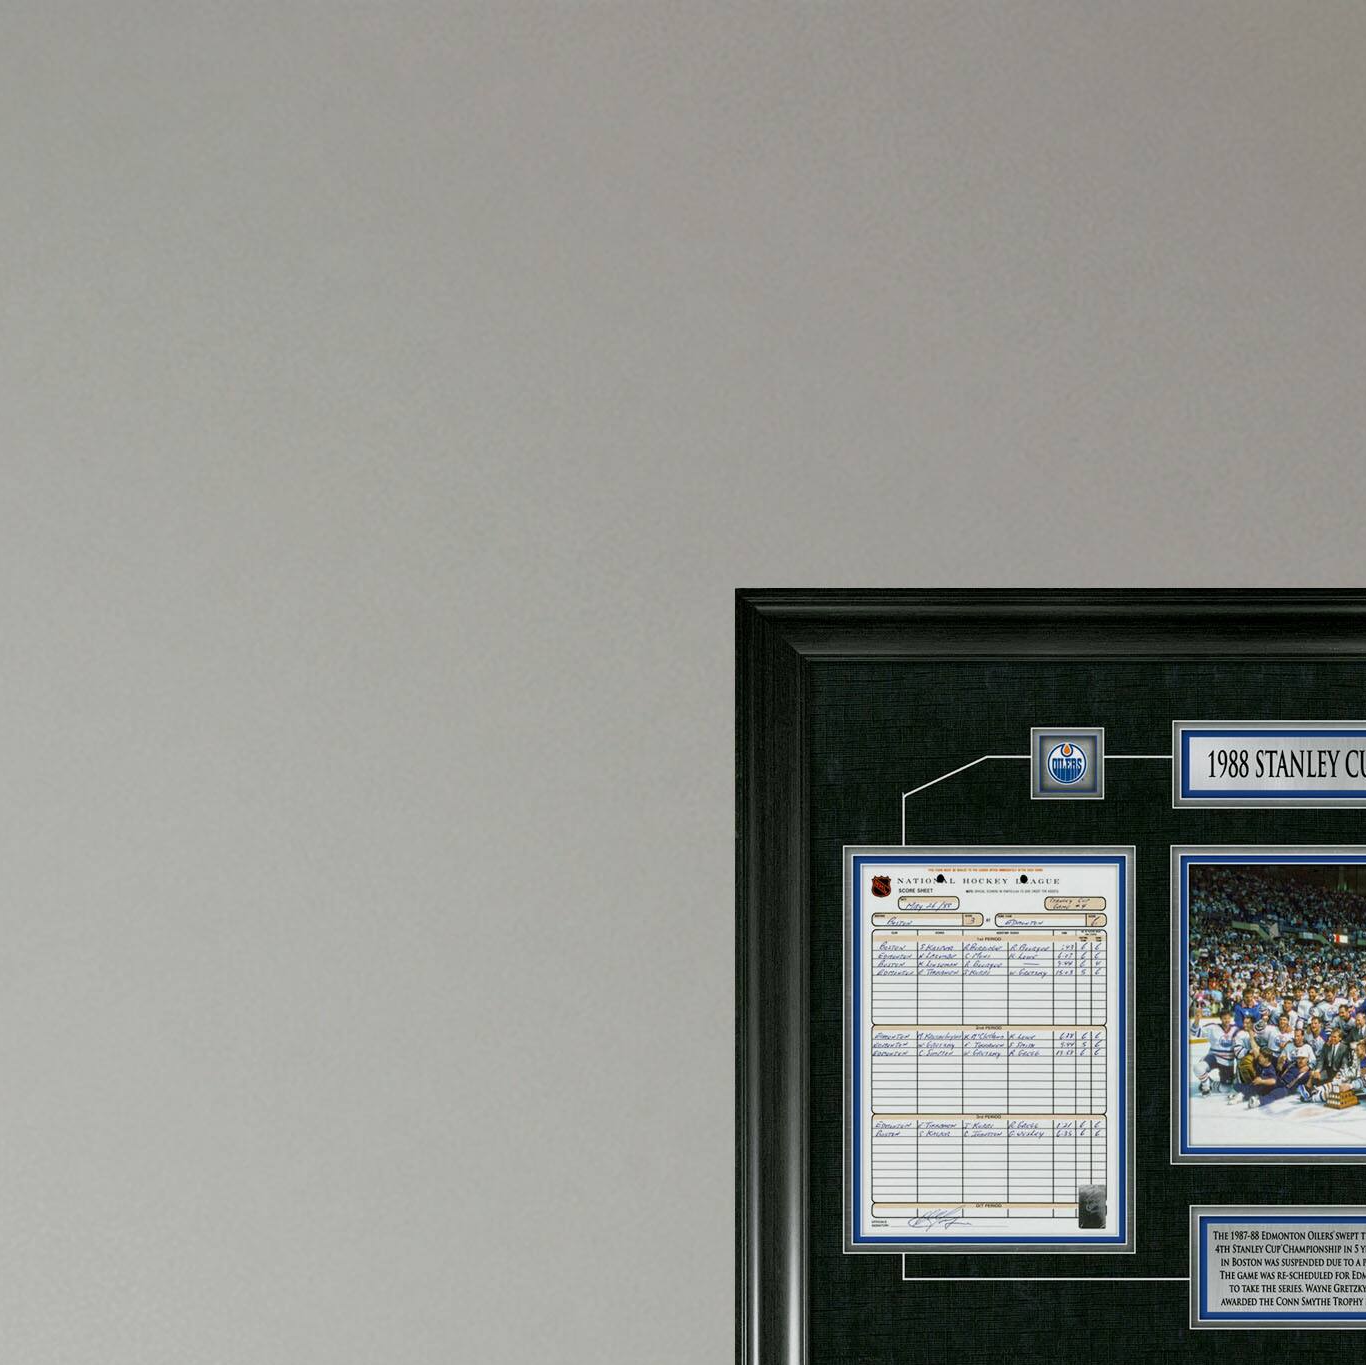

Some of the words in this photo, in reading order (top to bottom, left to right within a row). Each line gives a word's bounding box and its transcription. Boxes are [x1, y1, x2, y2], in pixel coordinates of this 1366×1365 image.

[1208, 749, 1249, 778] 1988
[1255, 749, 1341, 778] STANLEY
[1213, 1231, 1229, 1240] THE
[1231, 1231, 1259, 1240] 1987-88
[1261, 1231, 1305, 1240] EDMONTON
[1335, 1231, 1358, 1240] SWEPT
[1215, 1244, 1230, 1254] 4TH
[1232, 1244, 1263, 1254] STANLEY
[1283, 1244, 1341, 1254] CHAMPIONSHIP
[1344, 1244, 1353, 1254] IN
[1355, 1244, 1359, 1254] 5
[1221, 1258, 1229, 1266] IN
[1232, 1258, 1263, 1266] BOSTON
[1264, 1258, 1279, 1266] WAS
[1281, 1258, 1325, 1266] SUSPENDED
[1327, 1258, 1341, 1266] DUE
[1343, 1258, 1354, 1266] TO
[1355, 1258, 1361, 1266] A
[1219, 1271, 1235, 1280] THE
[1237, 1271, 1258, 1280] GAME
[1259, 1271, 1275, 1280] WAS
[1277, 1271, 1333, 1280] RE-SCHEDULED
[1335, 1271, 1350, 1280] FOR
[1229, 1284, 1240, 1292] TO
[1241, 1284, 1259, 1292] TAKE
[1261, 1284, 1276, 1292] THE
[1278, 1284, 1303, 1292] SERIES.
[1305, 1284, 1331, 1292] WAYNE
[1333, 1284, 1366, 1292] GRETZKY
[1221, 1297, 1257, 1306] AWARDED
[1259, 1297, 1274, 1306] THE
[1275, 1297, 1299, 1306] CONN
[1301, 1297, 1331, 1306] SMYTHE
[1333, 1297, 1363, 1306] TROPHY
